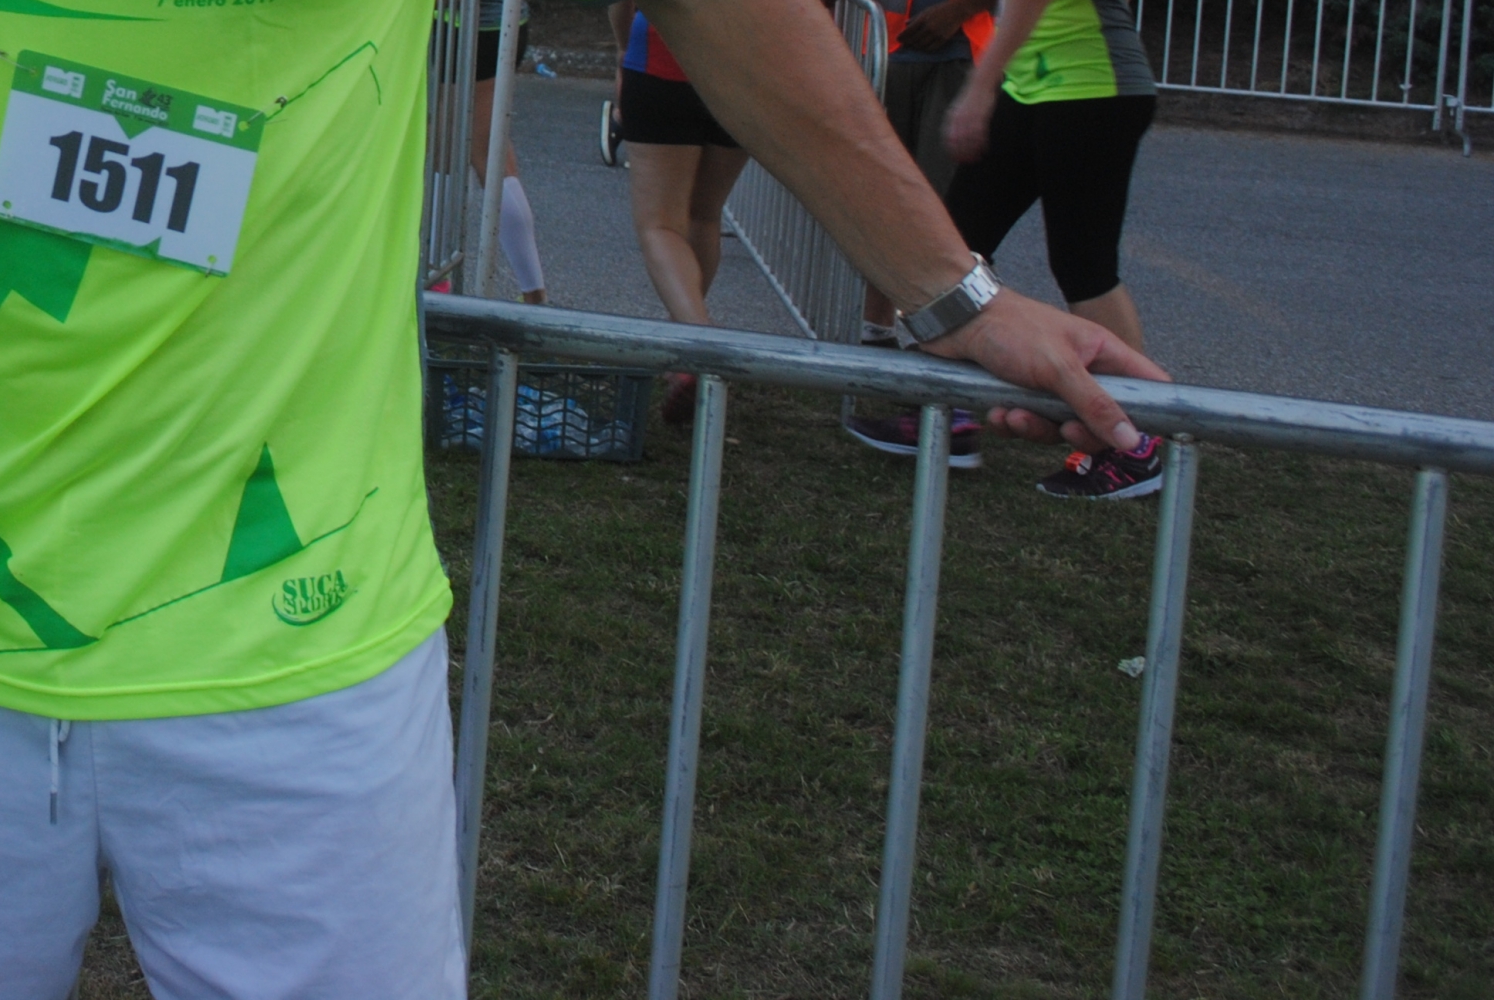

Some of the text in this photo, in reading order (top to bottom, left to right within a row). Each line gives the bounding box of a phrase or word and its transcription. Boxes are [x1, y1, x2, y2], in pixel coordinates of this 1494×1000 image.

[102, 89, 169, 121] Fernando
[106, 79, 137, 101] San
[49, 130, 201, 233] 1511
[282, 570, 348, 603] SUCA
